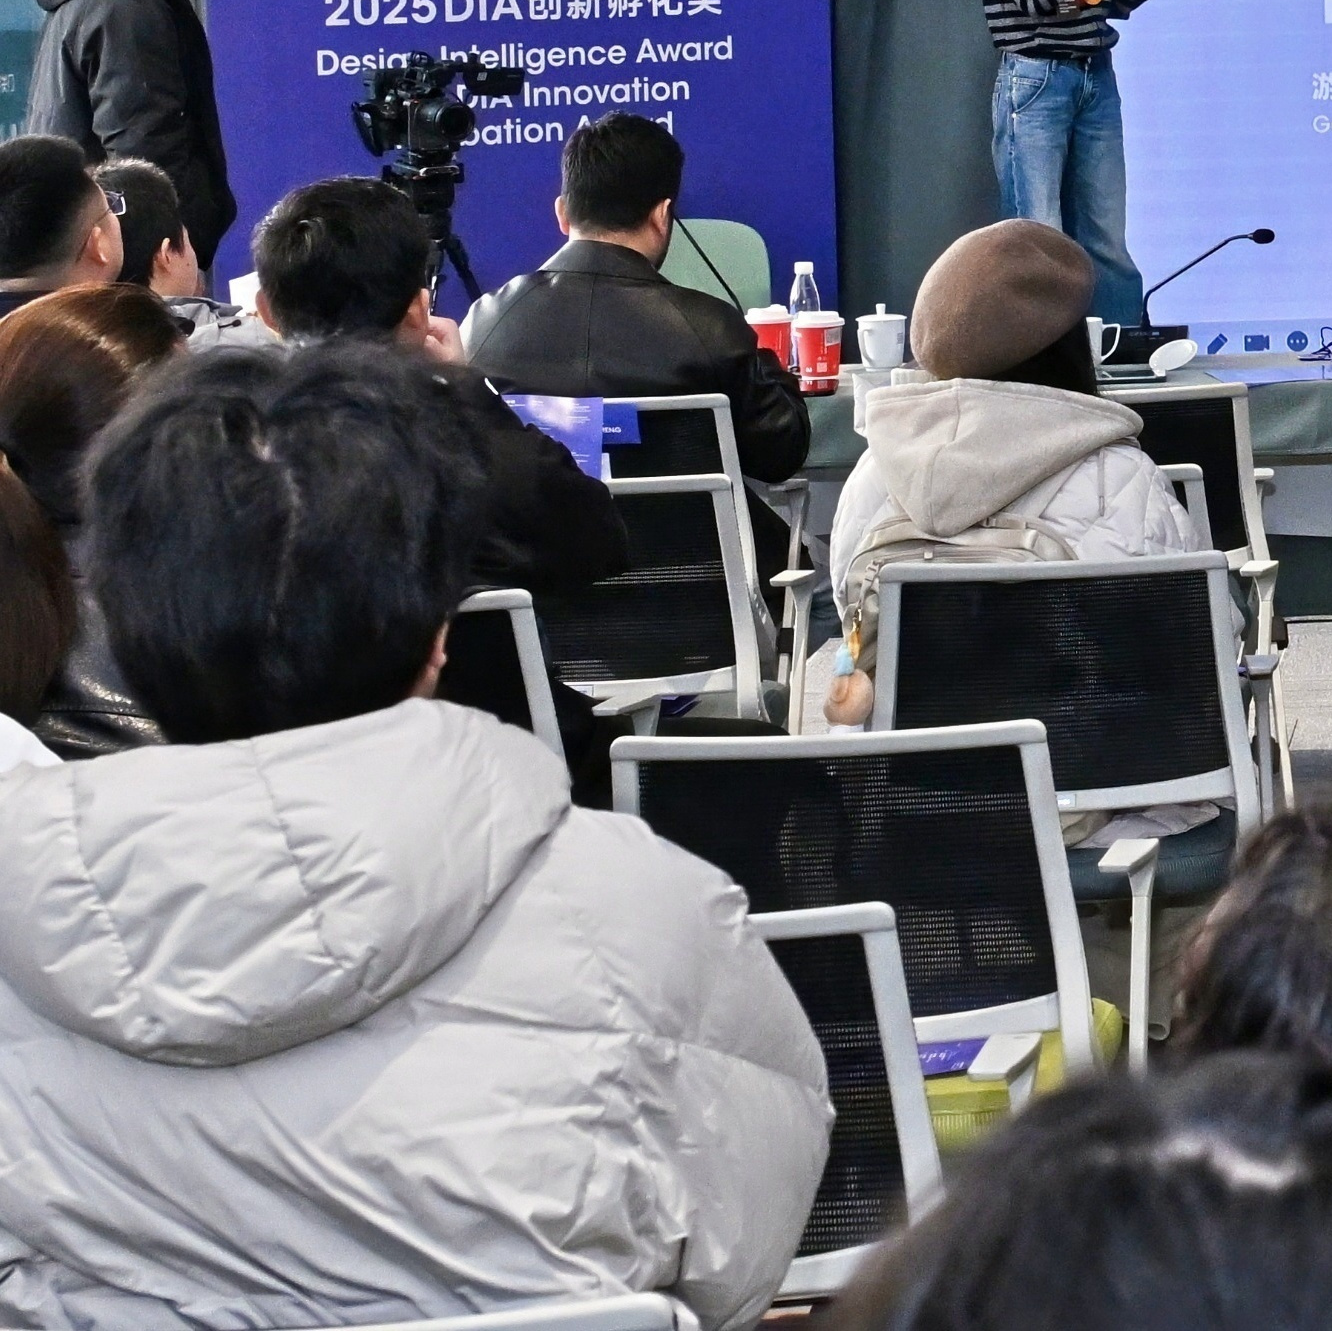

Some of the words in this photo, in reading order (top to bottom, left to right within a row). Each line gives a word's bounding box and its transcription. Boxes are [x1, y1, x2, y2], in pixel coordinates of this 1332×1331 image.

[317, 48, 409, 76] Desig
[635, 35, 734, 64] Award
[524, 76, 691, 108] Innovation
